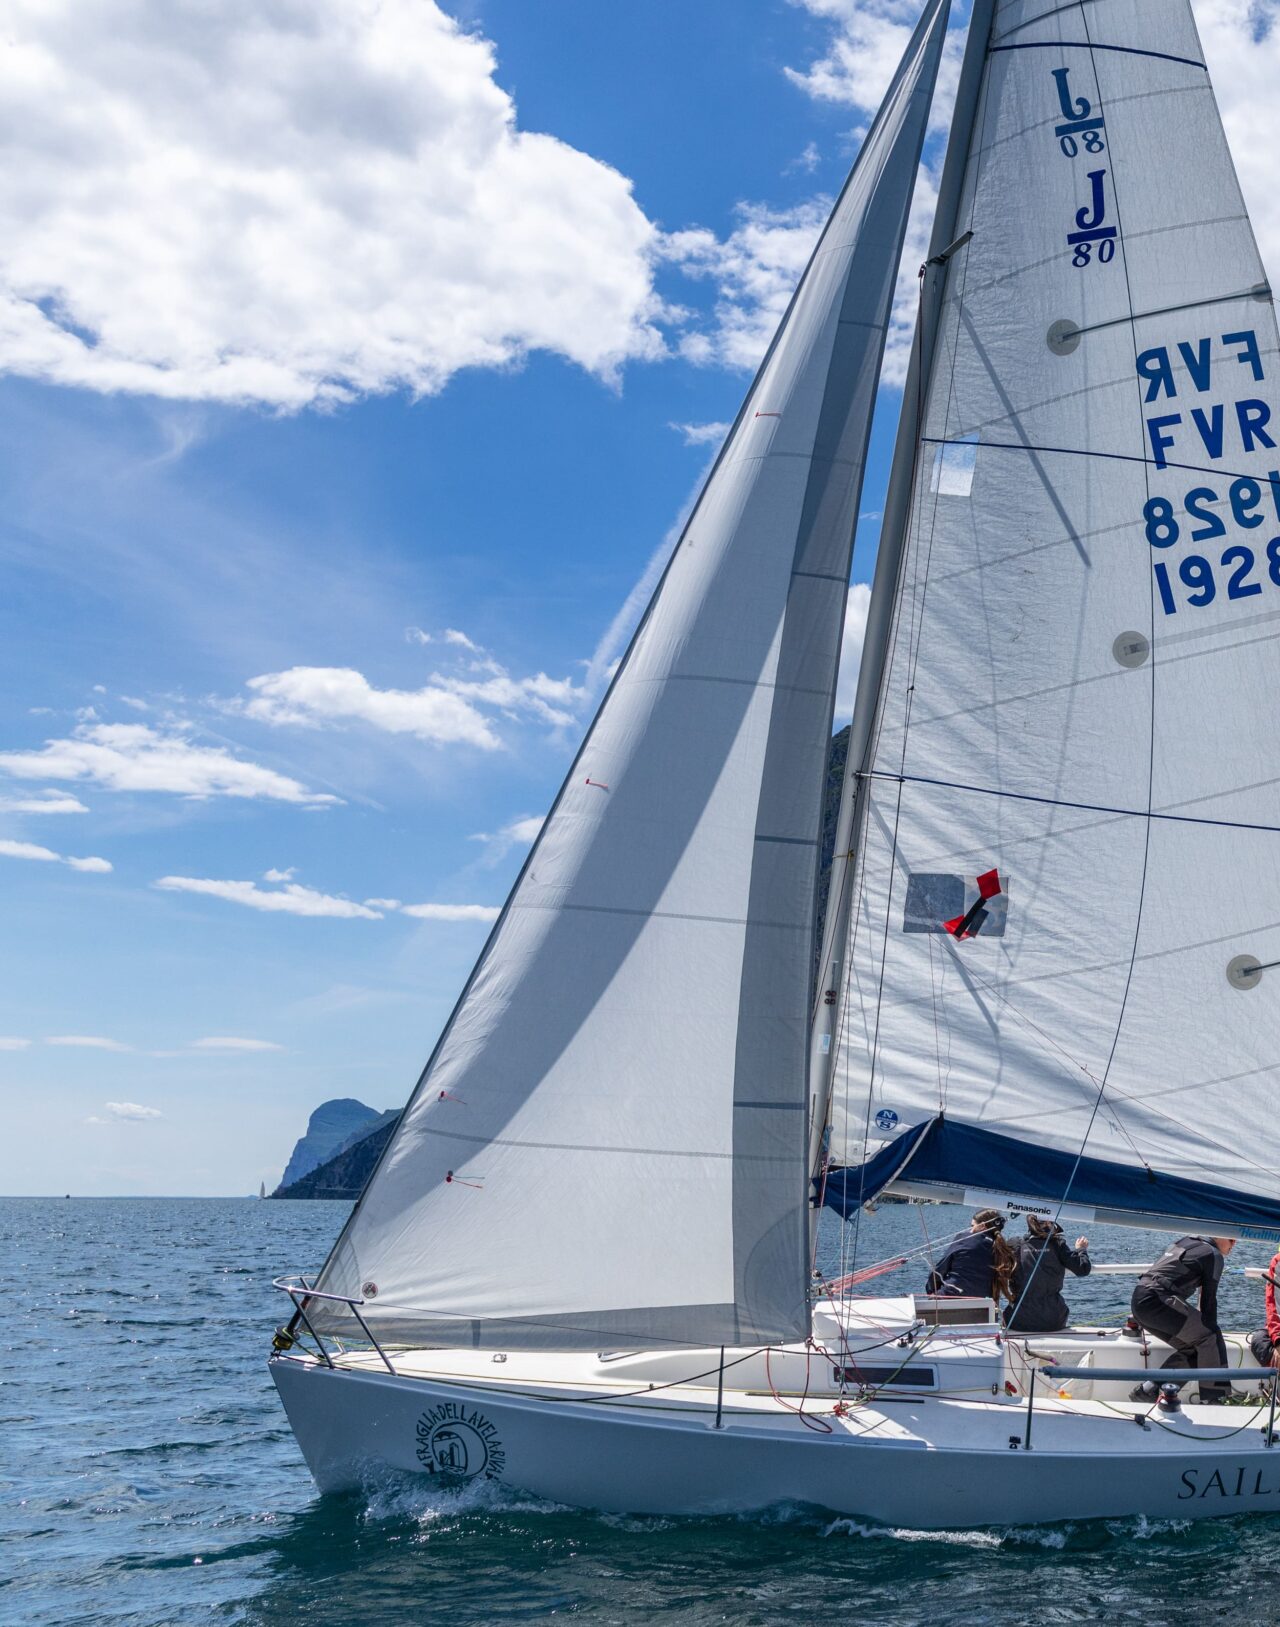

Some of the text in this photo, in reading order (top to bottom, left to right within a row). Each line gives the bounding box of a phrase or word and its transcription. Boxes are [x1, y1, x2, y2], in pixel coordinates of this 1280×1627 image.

[1075, 169, 1106, 230] J
[1072, 238, 1115, 267] 80
[1146, 399, 1277, 470] FVR
[1006, 1201, 1052, 1215] Panasonic
[1240, 1227, 1280, 1243] Healthy
[415, 1408, 441, 1461] FRAGLIA
[437, 1402, 479, 1427] DELLA
[476, 1414, 503, 1452] VELA
